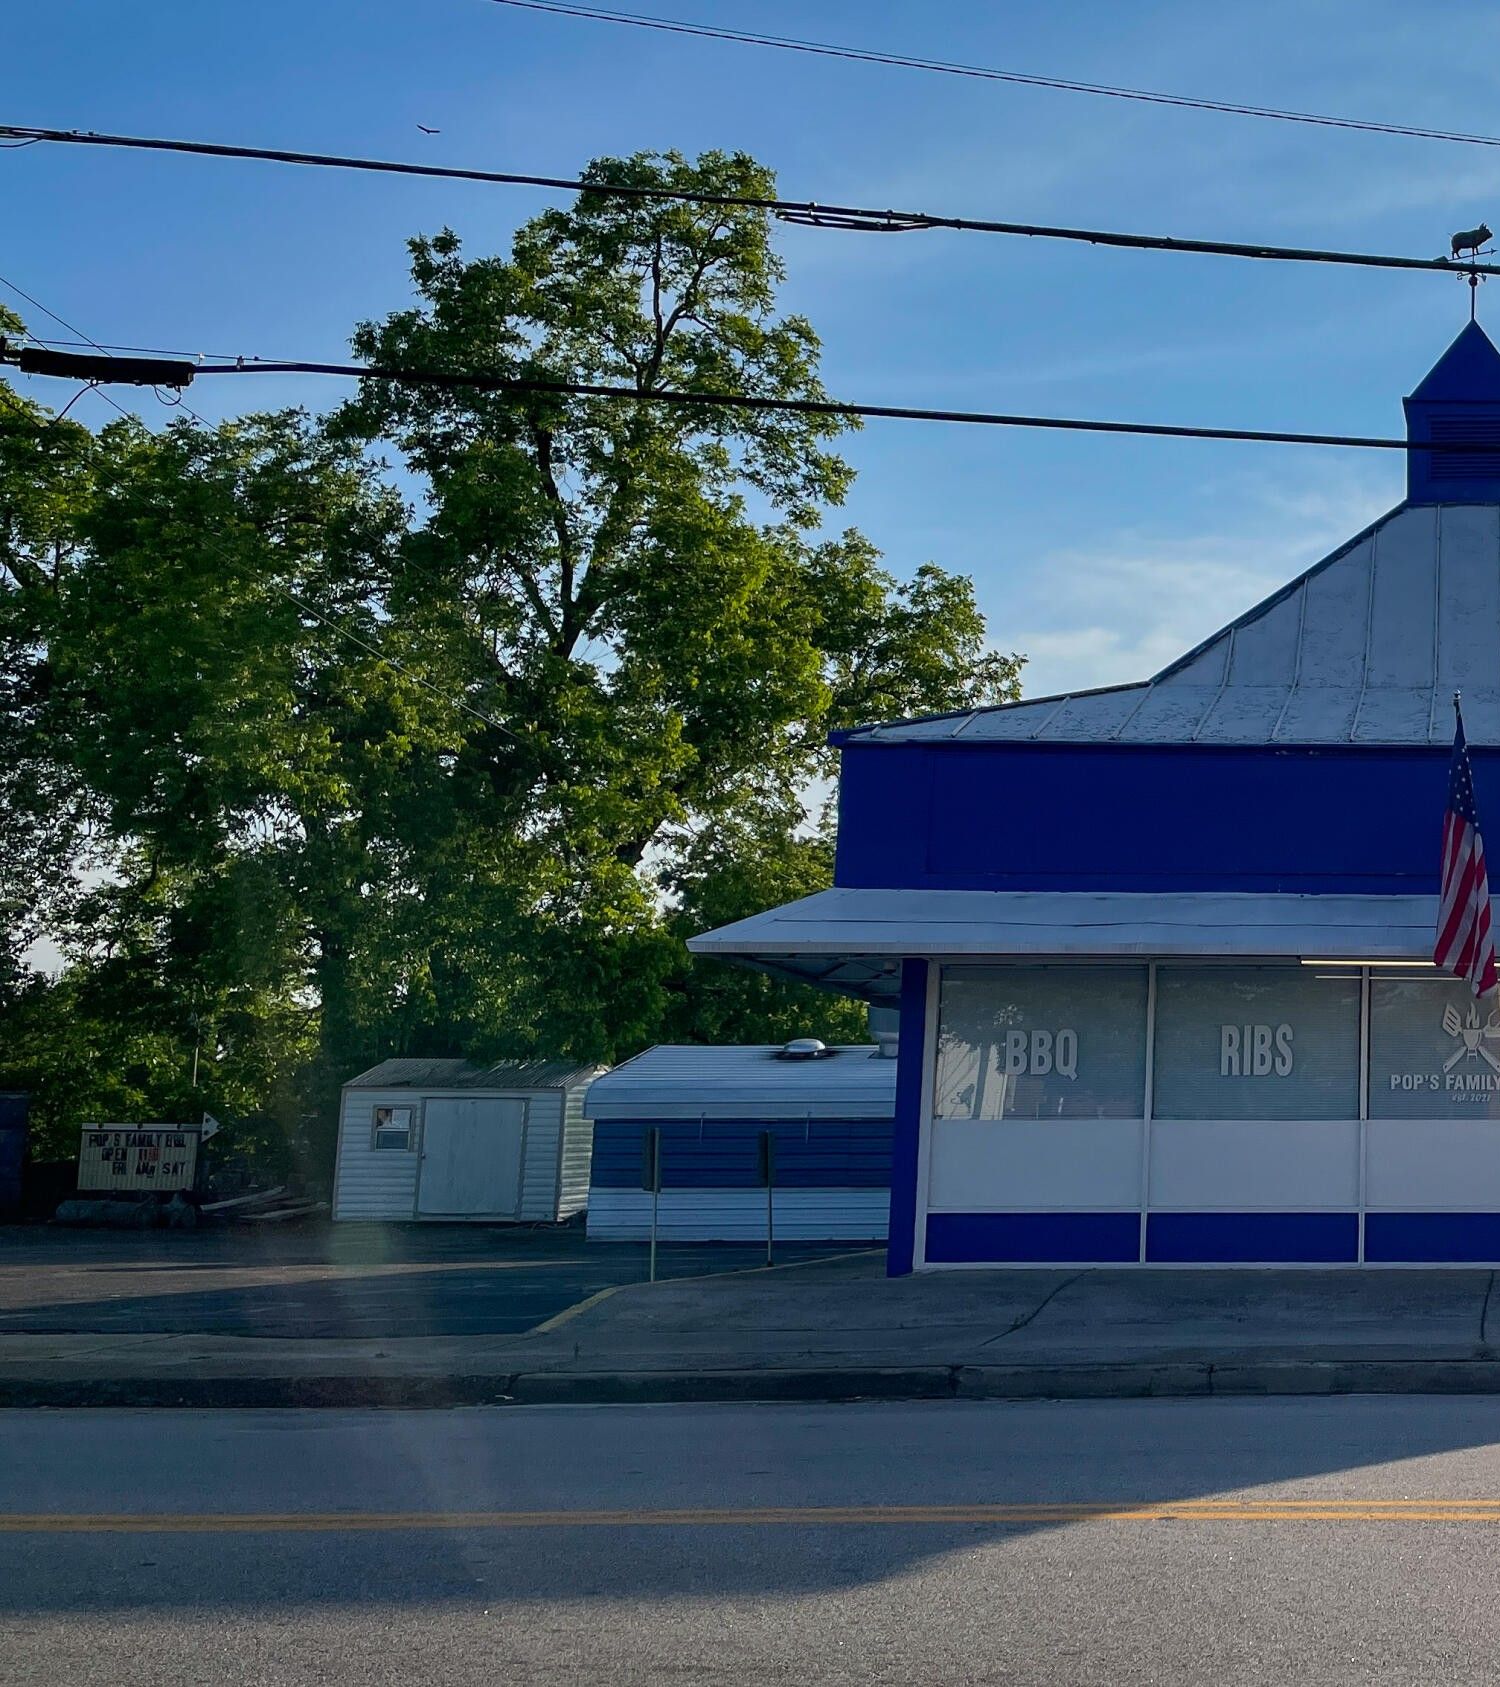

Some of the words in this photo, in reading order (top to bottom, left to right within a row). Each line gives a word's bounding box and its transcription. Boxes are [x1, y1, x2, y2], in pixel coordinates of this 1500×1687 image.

[1005, 1029, 1078, 1081] BBQ
[1220, 1024, 1294, 1077] RIBS
[1390, 1074, 1439, 1091] POP'S
[126, 1134, 162, 1147] FAMILY
[102, 1148, 127, 1161] OPEN
[162, 1162, 185, 1175] SAT
